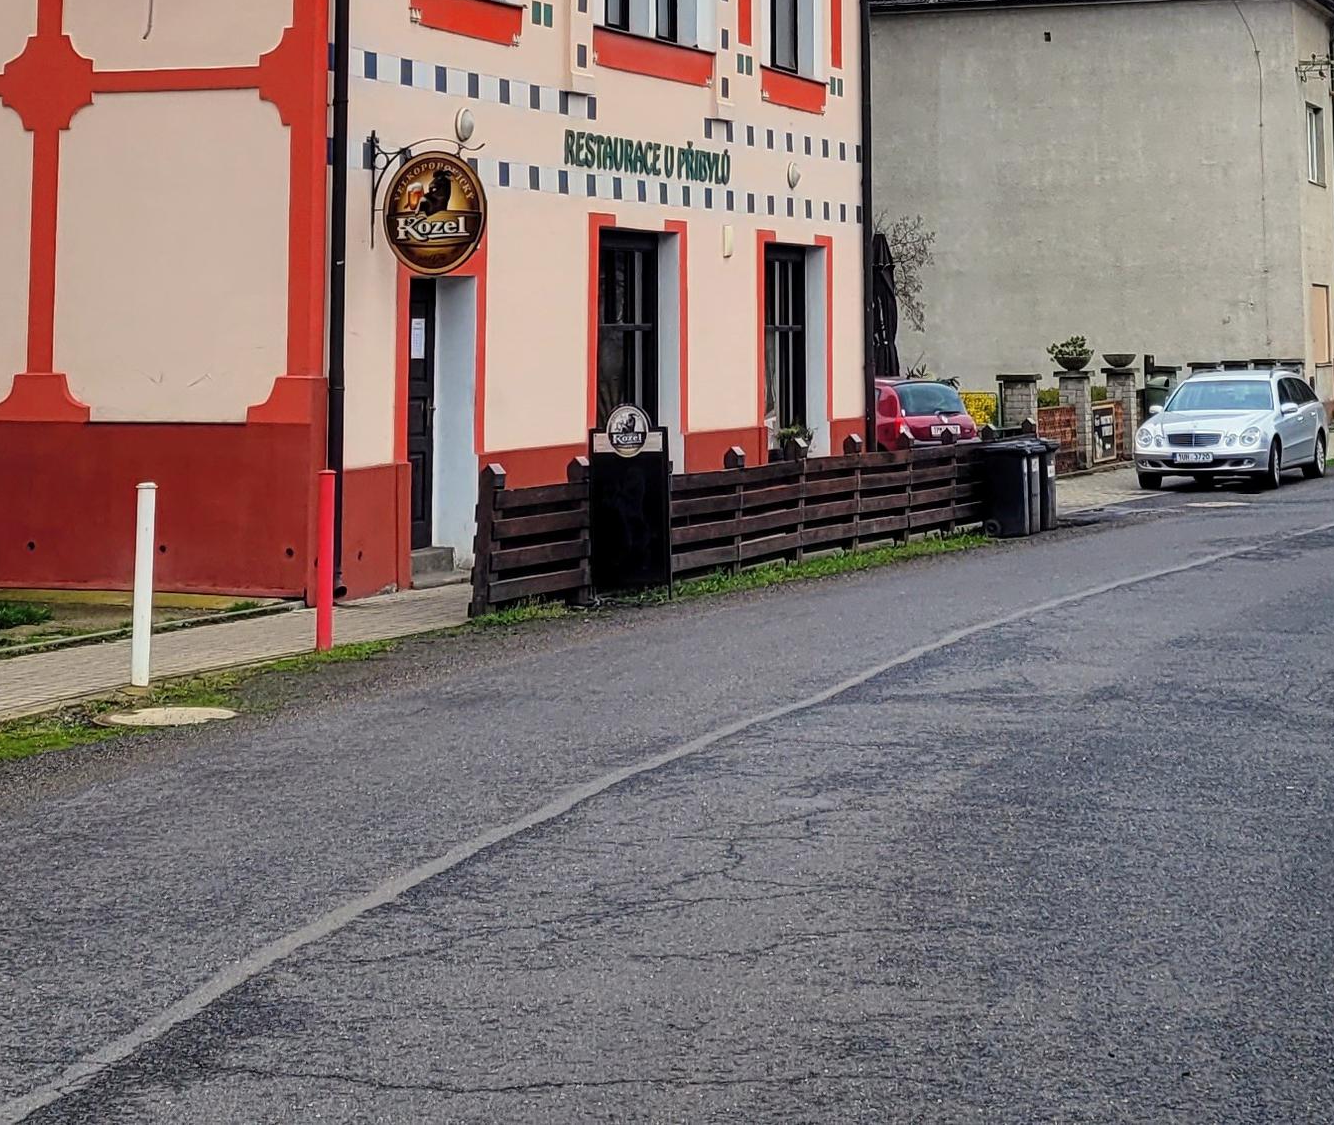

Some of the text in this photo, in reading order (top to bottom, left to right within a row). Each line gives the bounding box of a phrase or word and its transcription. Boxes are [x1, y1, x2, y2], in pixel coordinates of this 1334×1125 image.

[564, 129, 661, 176] RESTAURACE
[664, 144, 675, 179] U
[396, 216, 471, 242] Kozel
[612, 433, 642, 445] Kozel
